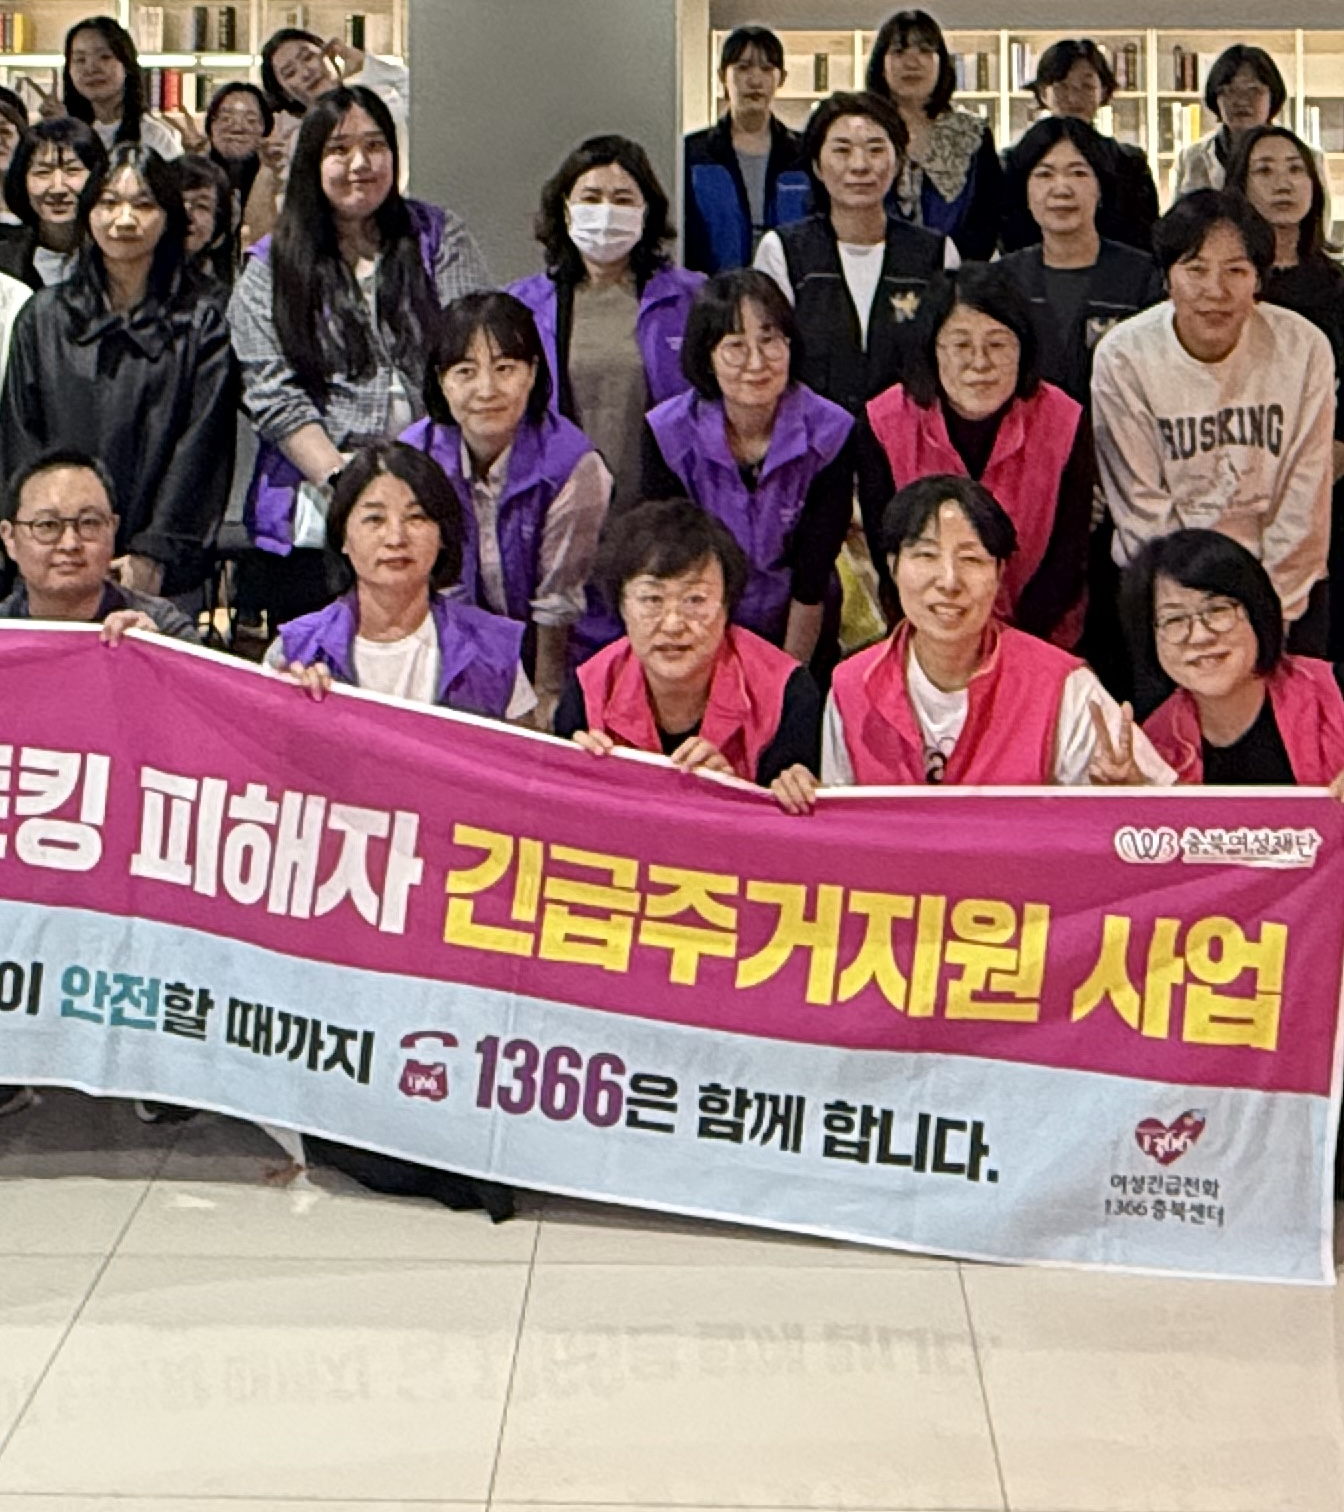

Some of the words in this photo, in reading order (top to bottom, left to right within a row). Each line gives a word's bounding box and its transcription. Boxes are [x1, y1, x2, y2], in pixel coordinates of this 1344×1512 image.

[129, 765, 424, 935] 피해자
[443, 822, 1051, 1024] 긴급주거지원
[1070, 914, 1289, 1051] 사업
[59, 963, 214, 1041] 안전할
[225, 996, 375, 1085] 때까지
[474, 1034, 678, 1133] 1366은
[696, 1082, 806, 1154] 함께
[821, 1099, 999, 1183] 합니다.
[1104, 1199, 1149, 1216] 1366
[1109, 1173, 1221, 1200] 여성긴급전화
